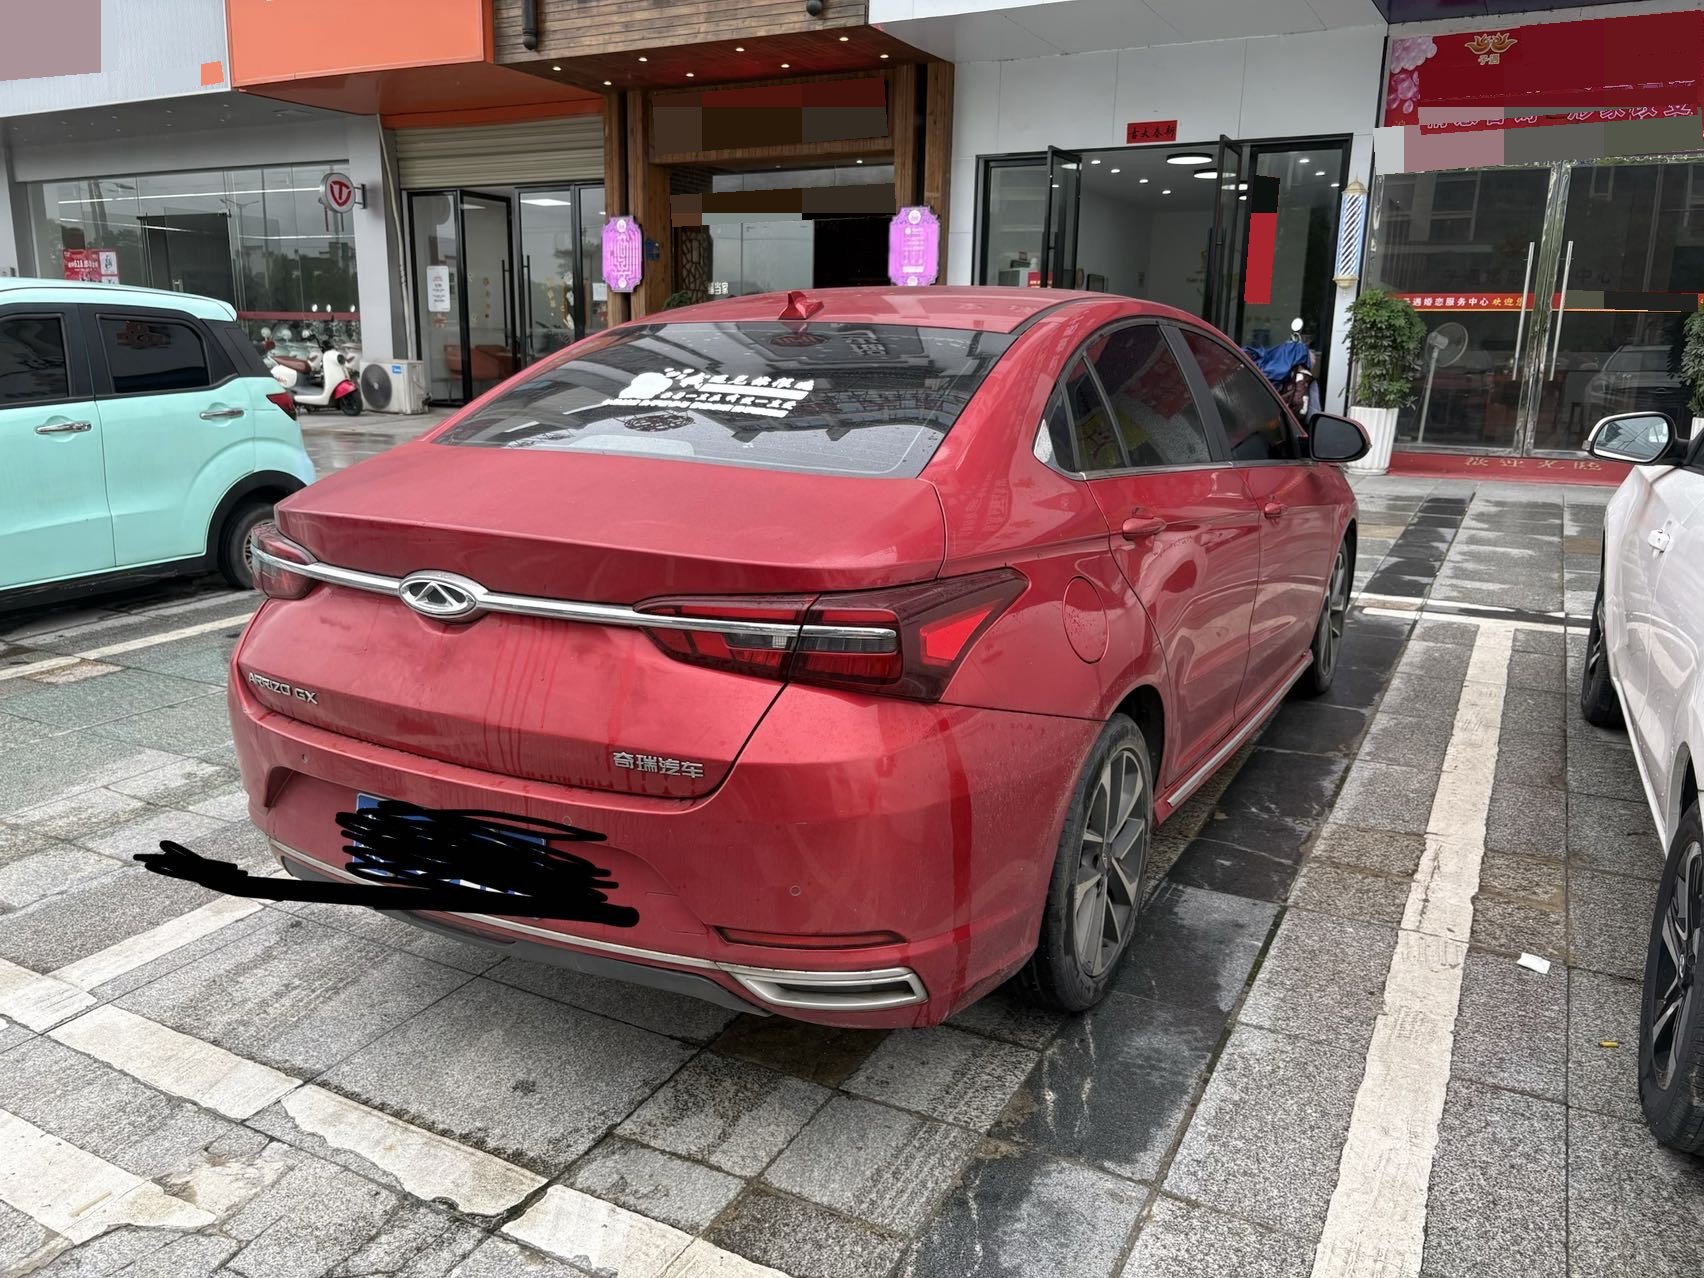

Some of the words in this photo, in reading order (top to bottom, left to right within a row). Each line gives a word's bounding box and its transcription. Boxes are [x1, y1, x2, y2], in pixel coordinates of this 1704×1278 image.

[248, 672, 291, 696] ARRIZO
[295, 688, 319, 705] GX
[613, 751, 704, 778] 奇瑞汽车
